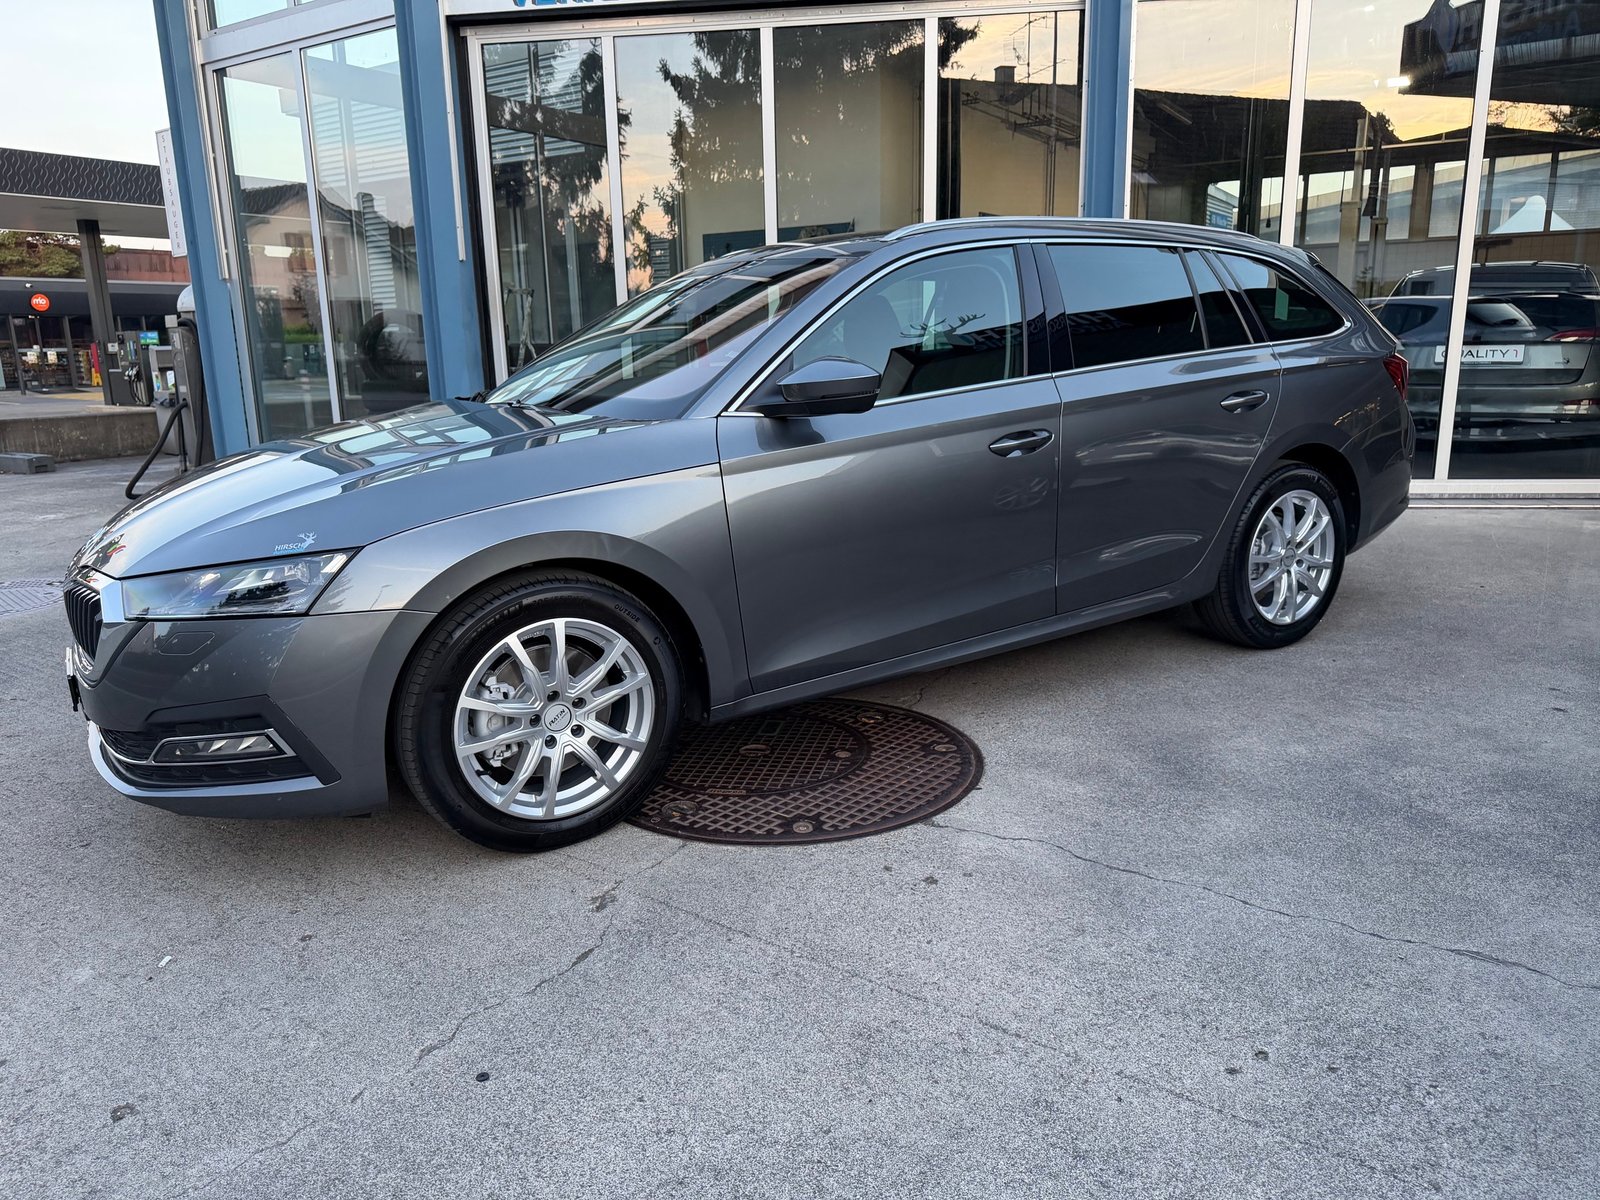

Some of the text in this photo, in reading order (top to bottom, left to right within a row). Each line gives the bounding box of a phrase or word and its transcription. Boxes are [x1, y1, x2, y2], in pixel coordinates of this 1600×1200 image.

[161, 135, 181, 249] STAUBSAUGER
[1441, 348, 1519, 359] ALITY 1
[274, 543, 302, 551] HIRSCH
[614, 603, 640, 622] OUTSIDE
